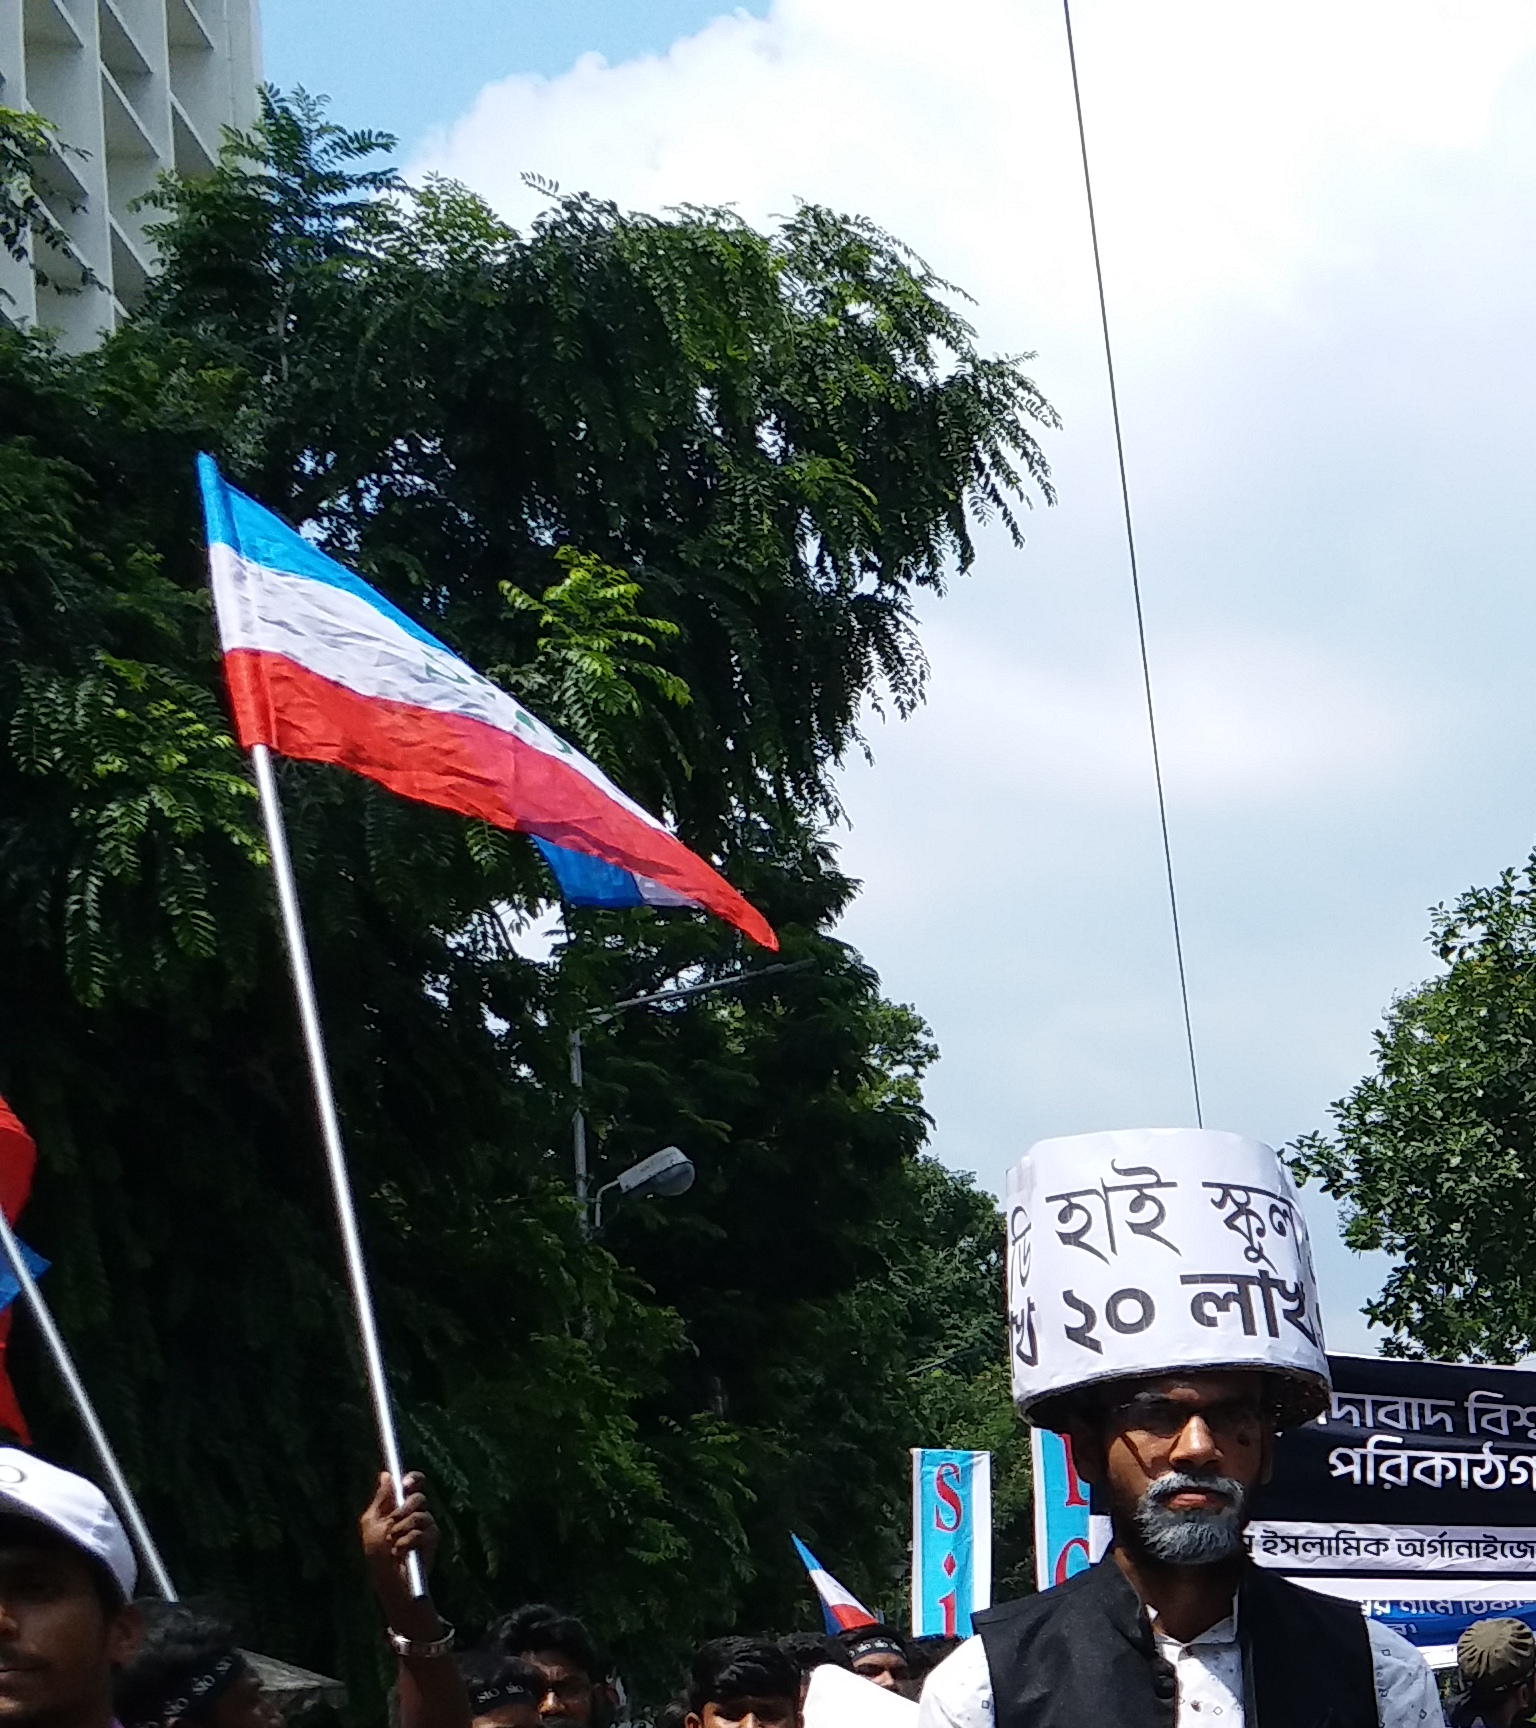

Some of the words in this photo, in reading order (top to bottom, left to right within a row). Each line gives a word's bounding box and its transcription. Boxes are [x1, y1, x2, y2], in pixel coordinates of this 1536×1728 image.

[1045, 1158, 1182, 1266] হাই
[1062, 1287, 1155, 1355] ২০
[1318, 1392, 1455, 1433] দাবাদ
[1261, 1530, 1390, 1558] ইসলামিক
